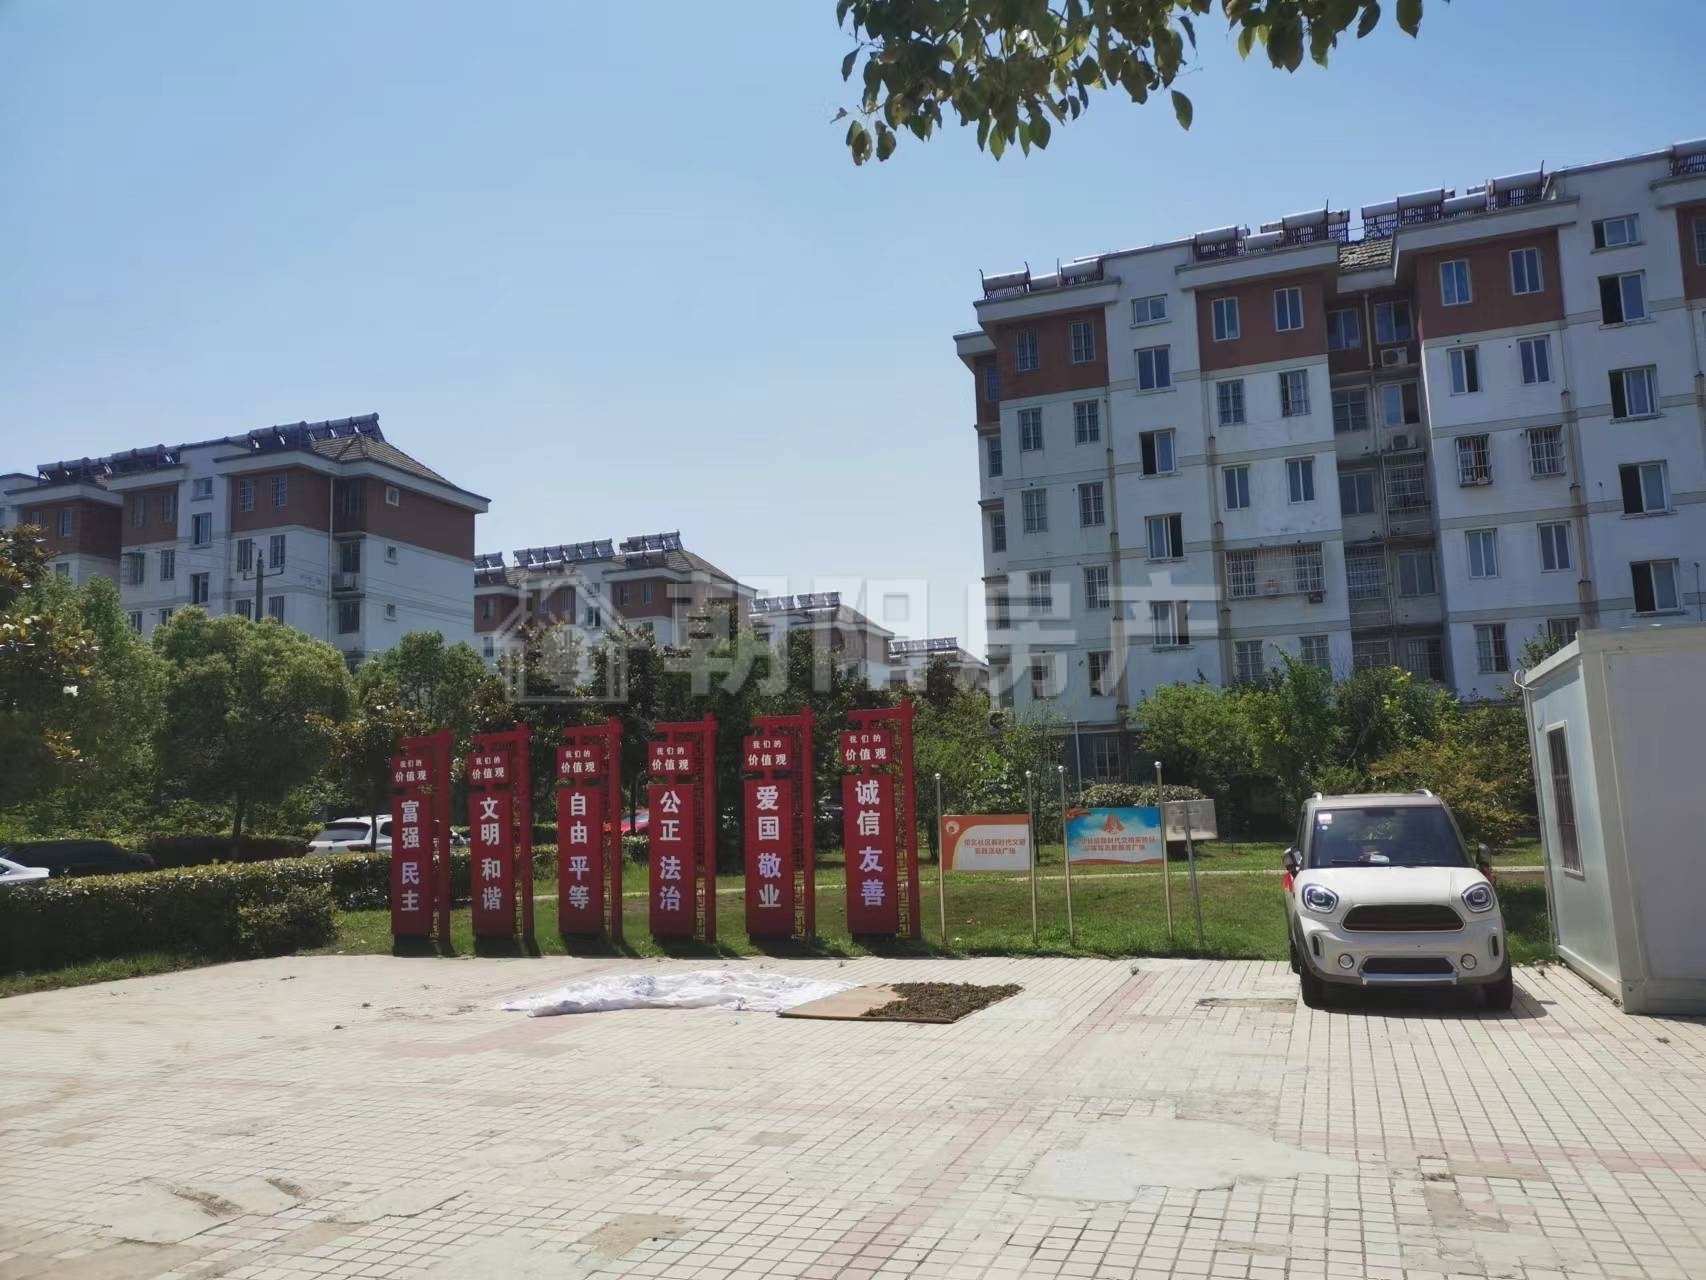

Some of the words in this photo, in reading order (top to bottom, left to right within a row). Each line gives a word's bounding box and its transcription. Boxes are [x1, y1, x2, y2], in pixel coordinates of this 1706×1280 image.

[752, 739, 783, 750] 我们的
[848, 733, 882, 744] 我们的
[564, 749, 592, 759] 我们的
[656, 746, 686, 756] 我们的
[844, 747, 888, 762] 价值观
[400, 759, 423, 769] 我们的
[475, 756, 502, 766] 我们的
[651, 758, 690, 771] 价值观
[747, 753, 788, 767] 价值观
[471, 767, 506, 780] 价值观
[560, 761, 597, 774] 价值观
[395, 770, 427, 783] 价值观
